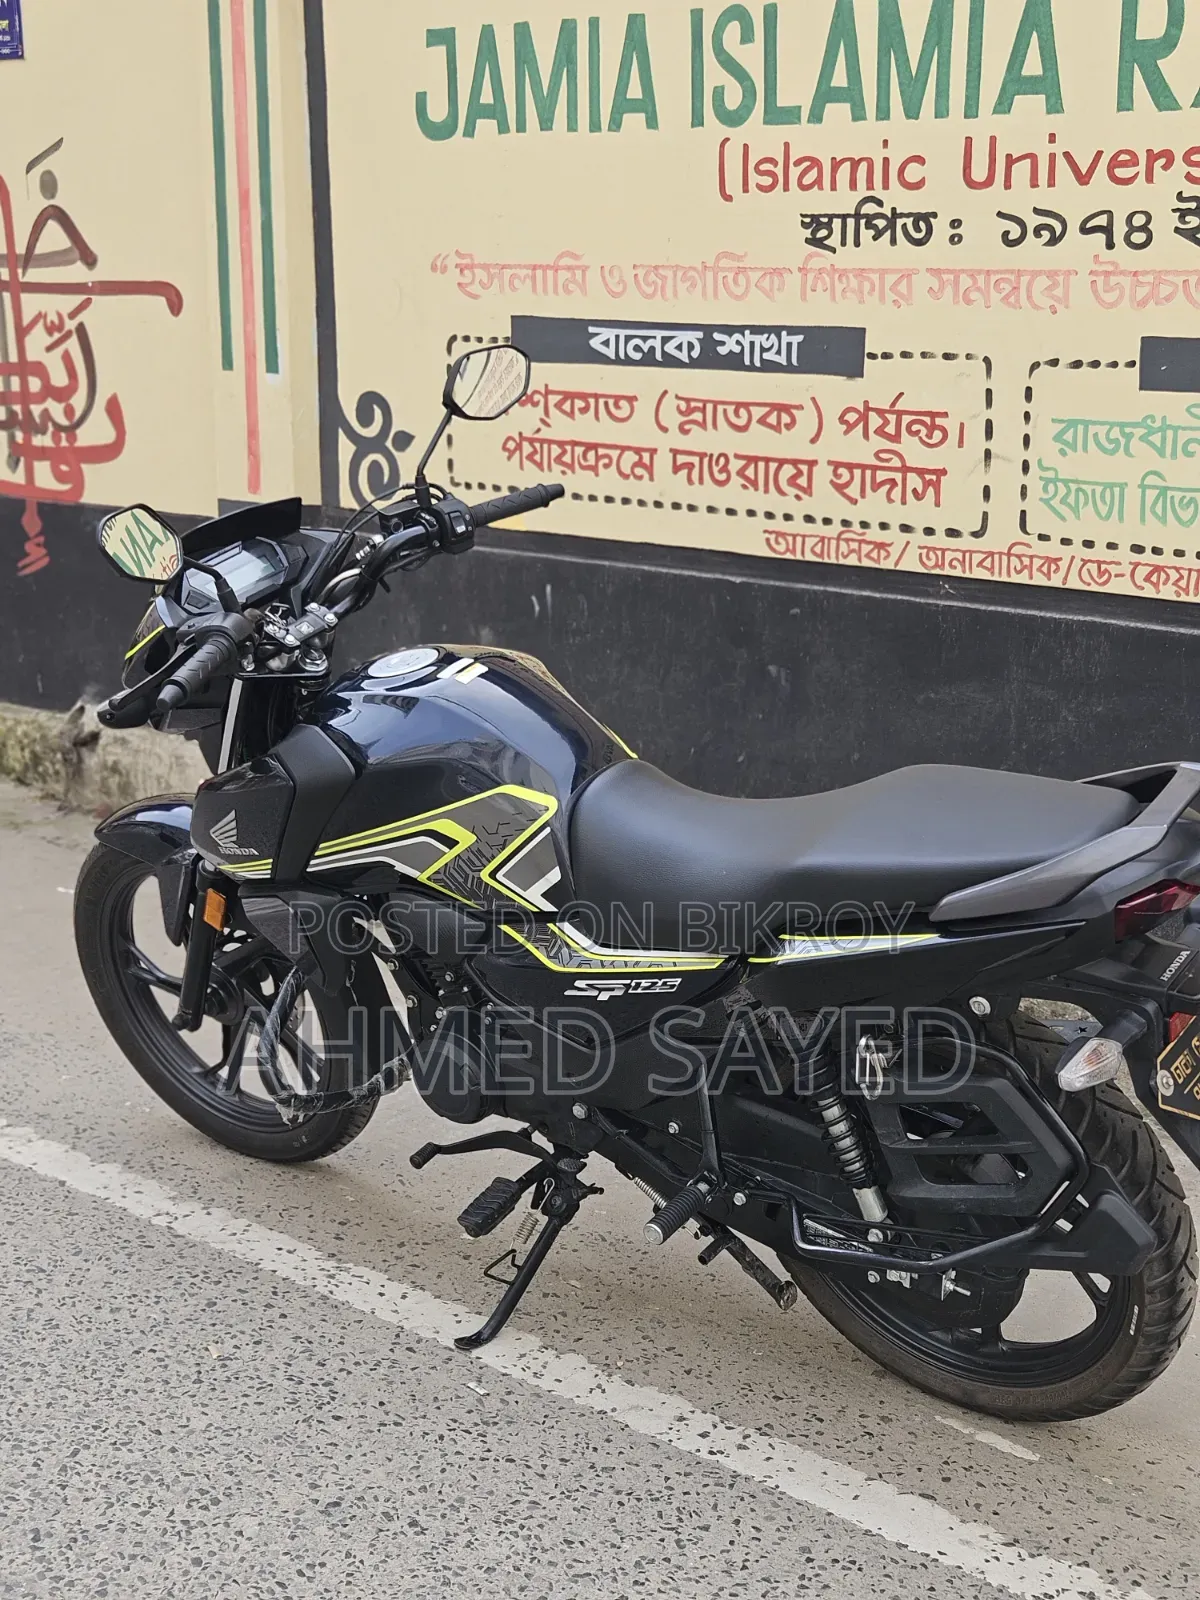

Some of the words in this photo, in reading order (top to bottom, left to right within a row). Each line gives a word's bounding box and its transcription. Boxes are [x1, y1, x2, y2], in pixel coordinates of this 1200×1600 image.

[415, 13, 659, 141] JAMIA
[690, 0, 1064, 128] ISLAMIA
[1116, 0, 1200, 113] R
[718, 137, 927, 202] (Islamic
[995, 206, 1154, 251] ১৯৭৪
[798, 251, 920, 309] শিক্ষার
[925, 265, 1078, 315] সমন্বয়ে
[588, 325, 703, 364] বালক
[712, 329, 804, 368] শাখা
[669, 447, 818, 500] দাওরায়ে
[827, 448, 948, 507] হাদীস
[1038, 457, 1128, 523] ইফতা
[219, 847, 259, 855] HONDA
[563, 979, 632, 1001] SP
[628, 978, 683, 993] 125
[1159, 950, 1191, 982] HONDA
